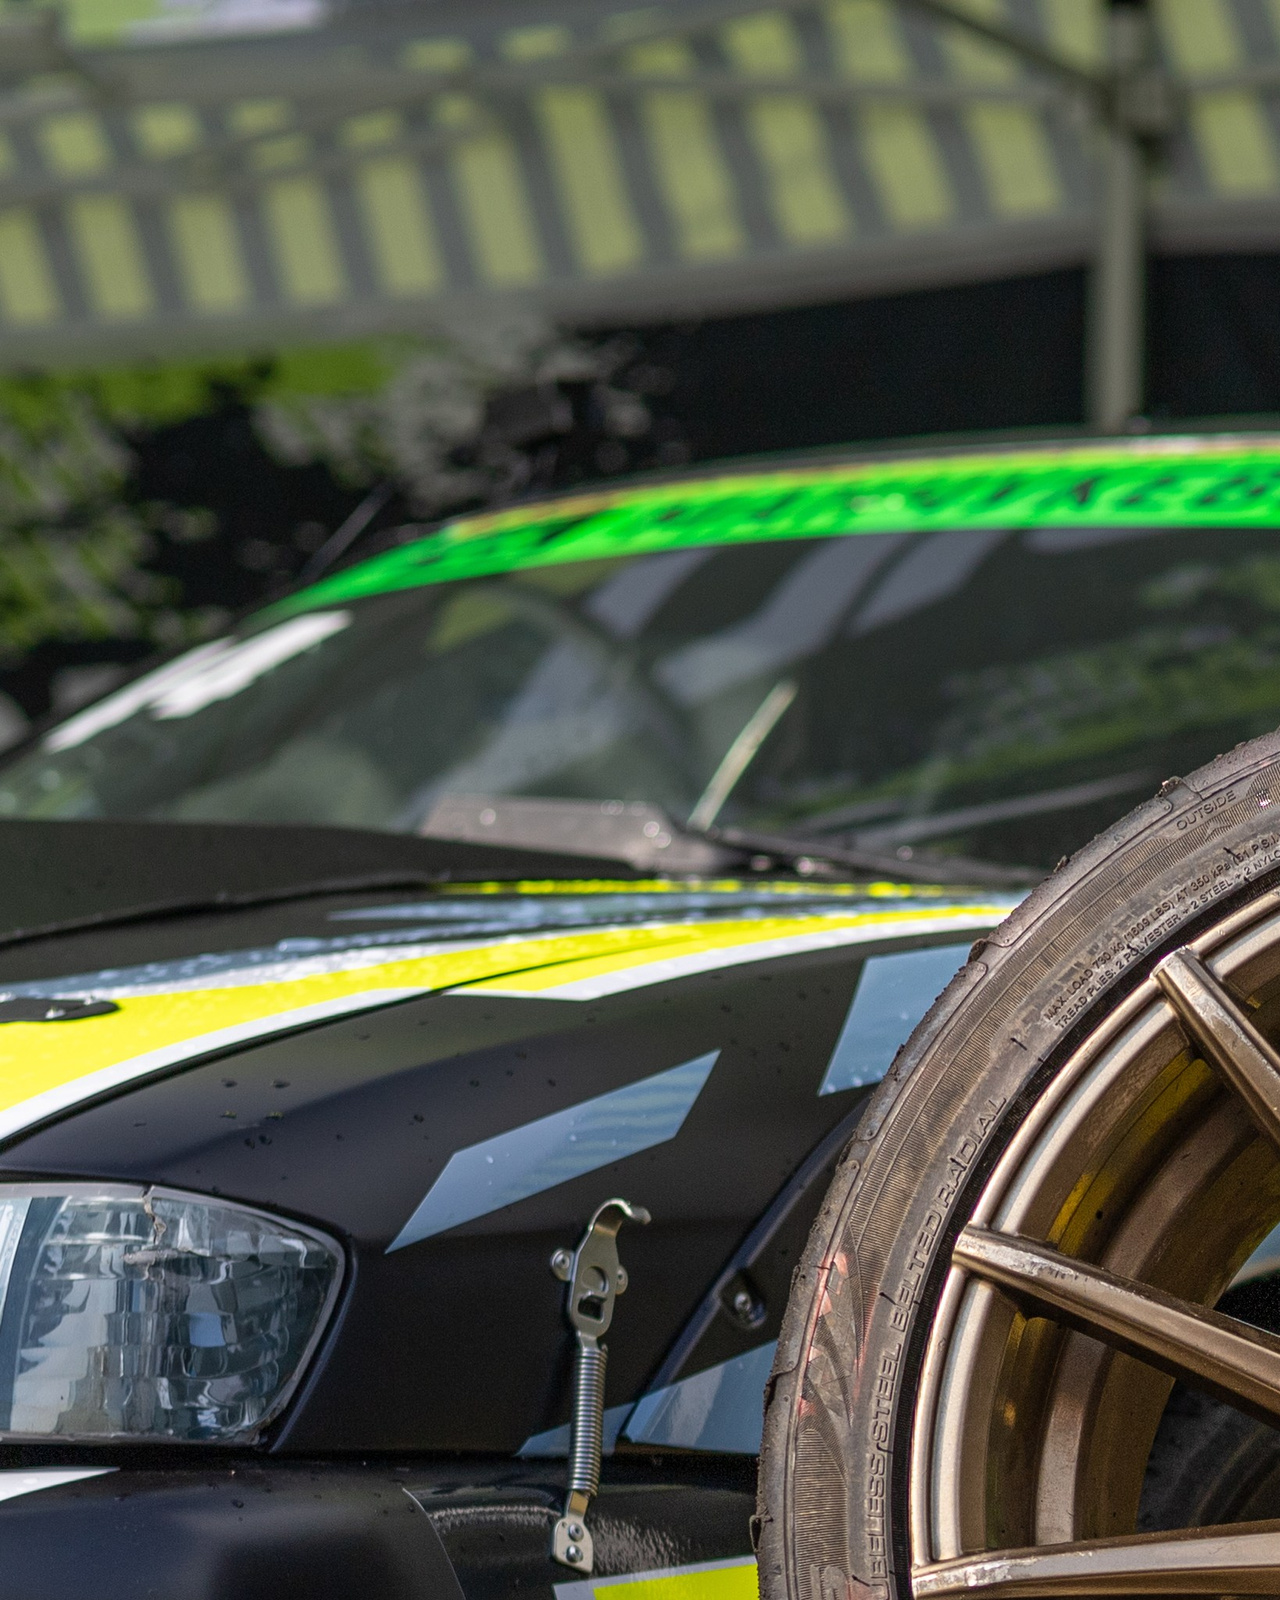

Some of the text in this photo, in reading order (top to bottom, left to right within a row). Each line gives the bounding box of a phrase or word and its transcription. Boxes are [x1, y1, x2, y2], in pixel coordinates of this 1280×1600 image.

[1173, 789, 1238, 832] OUTSIDE
[1042, 991, 1070, 1021] MAX.
[1064, 966, 1095, 997] LOAD
[1090, 948, 1113, 971] 730
[1107, 937, 1127, 956] kg
[1147, 897, 1176, 922] LBS)
[1171, 885, 1191, 903] AT
[1187, 872, 1211, 892] 350
[1053, 992, 1089, 1031] TREAD
[1084, 965, 1117, 997] PLIES:
[1112, 957, 1125, 970] 2
[1120, 911, 1182, 963] POLYESTER
[1187, 898, 1200, 911] 2
[1196, 876, 1234, 904] STEEL
[1241, 864, 1253, 877] 2
[869, 1338, 902, 1443] STEEL
[886, 1206, 945, 1333] BELTED
[929, 1087, 1009, 1210] RADIAL
